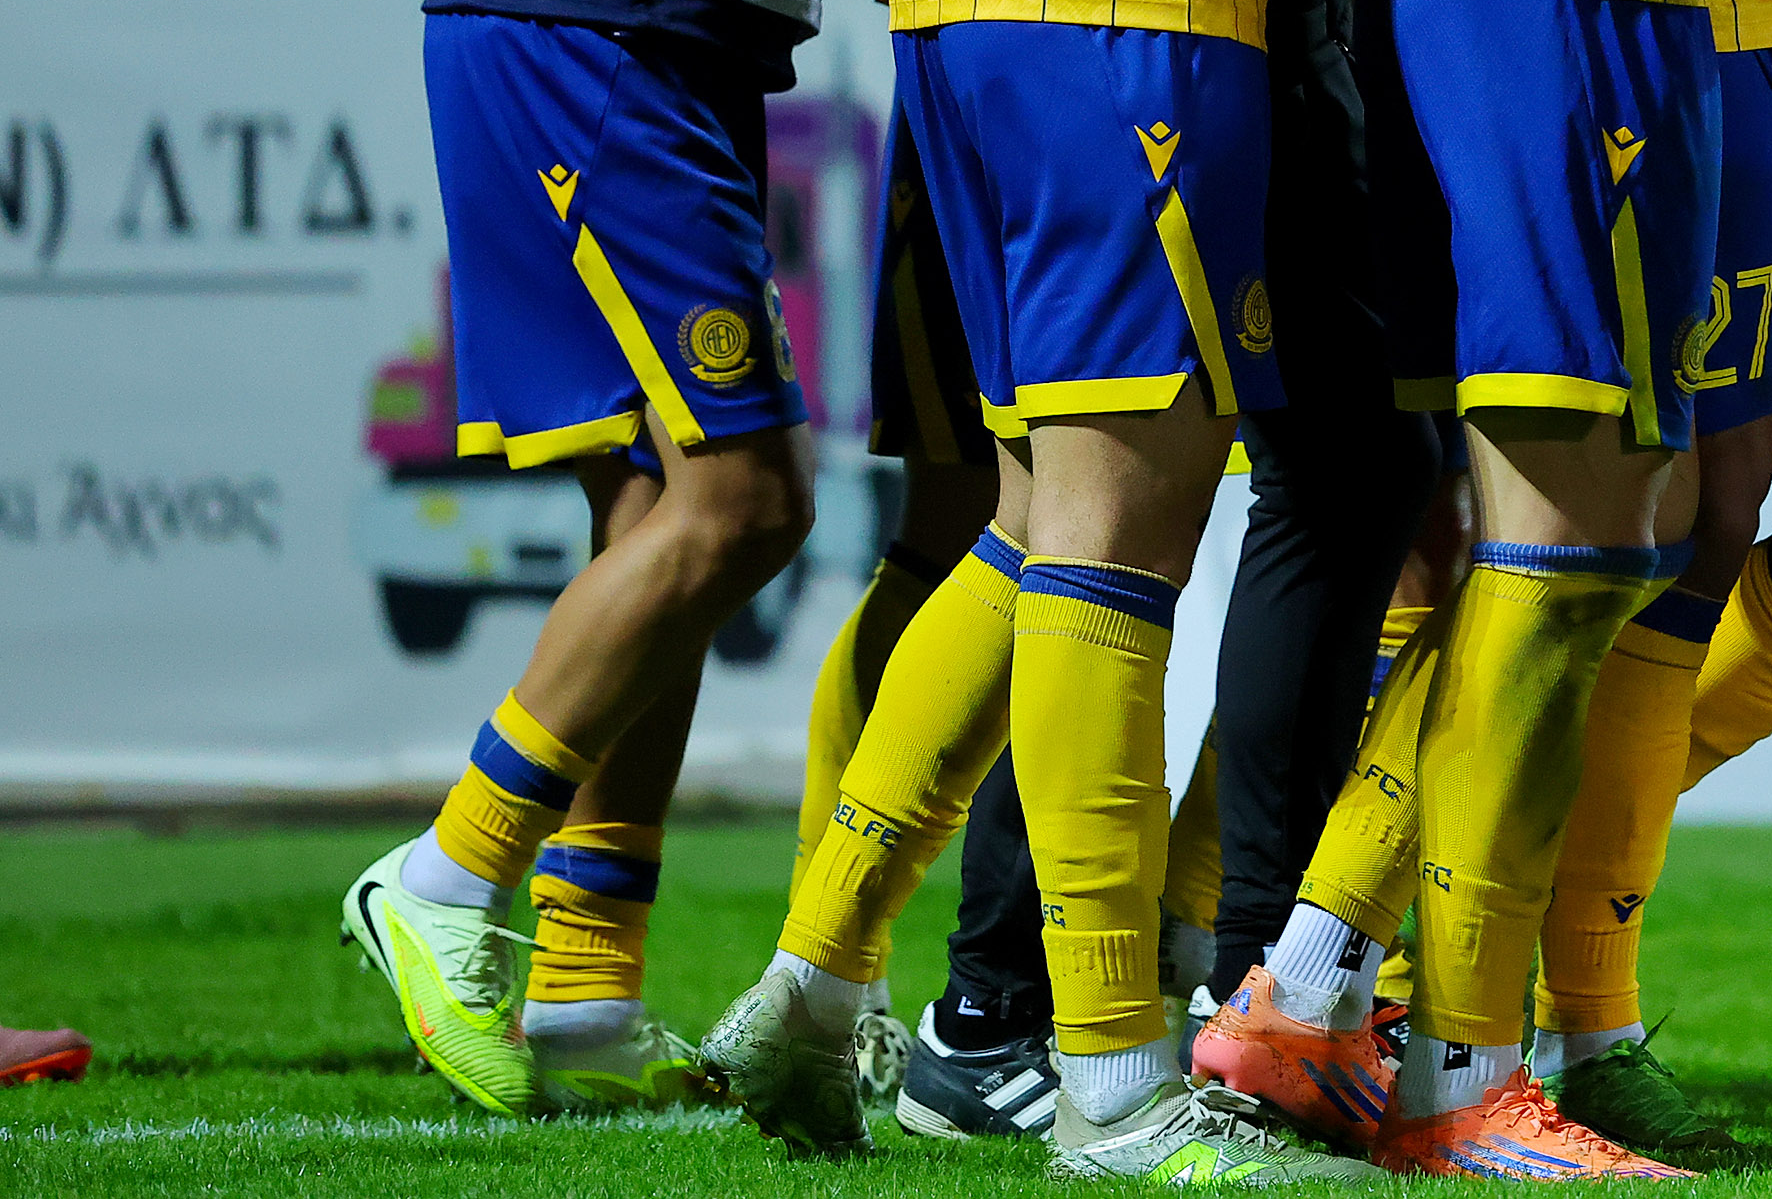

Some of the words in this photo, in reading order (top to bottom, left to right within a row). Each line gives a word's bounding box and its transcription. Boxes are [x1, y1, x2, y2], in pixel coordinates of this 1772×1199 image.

[834, 802, 857, 833] EL
[1422, 861, 1453, 892] FC
[1042, 903, 1067, 929] FC
